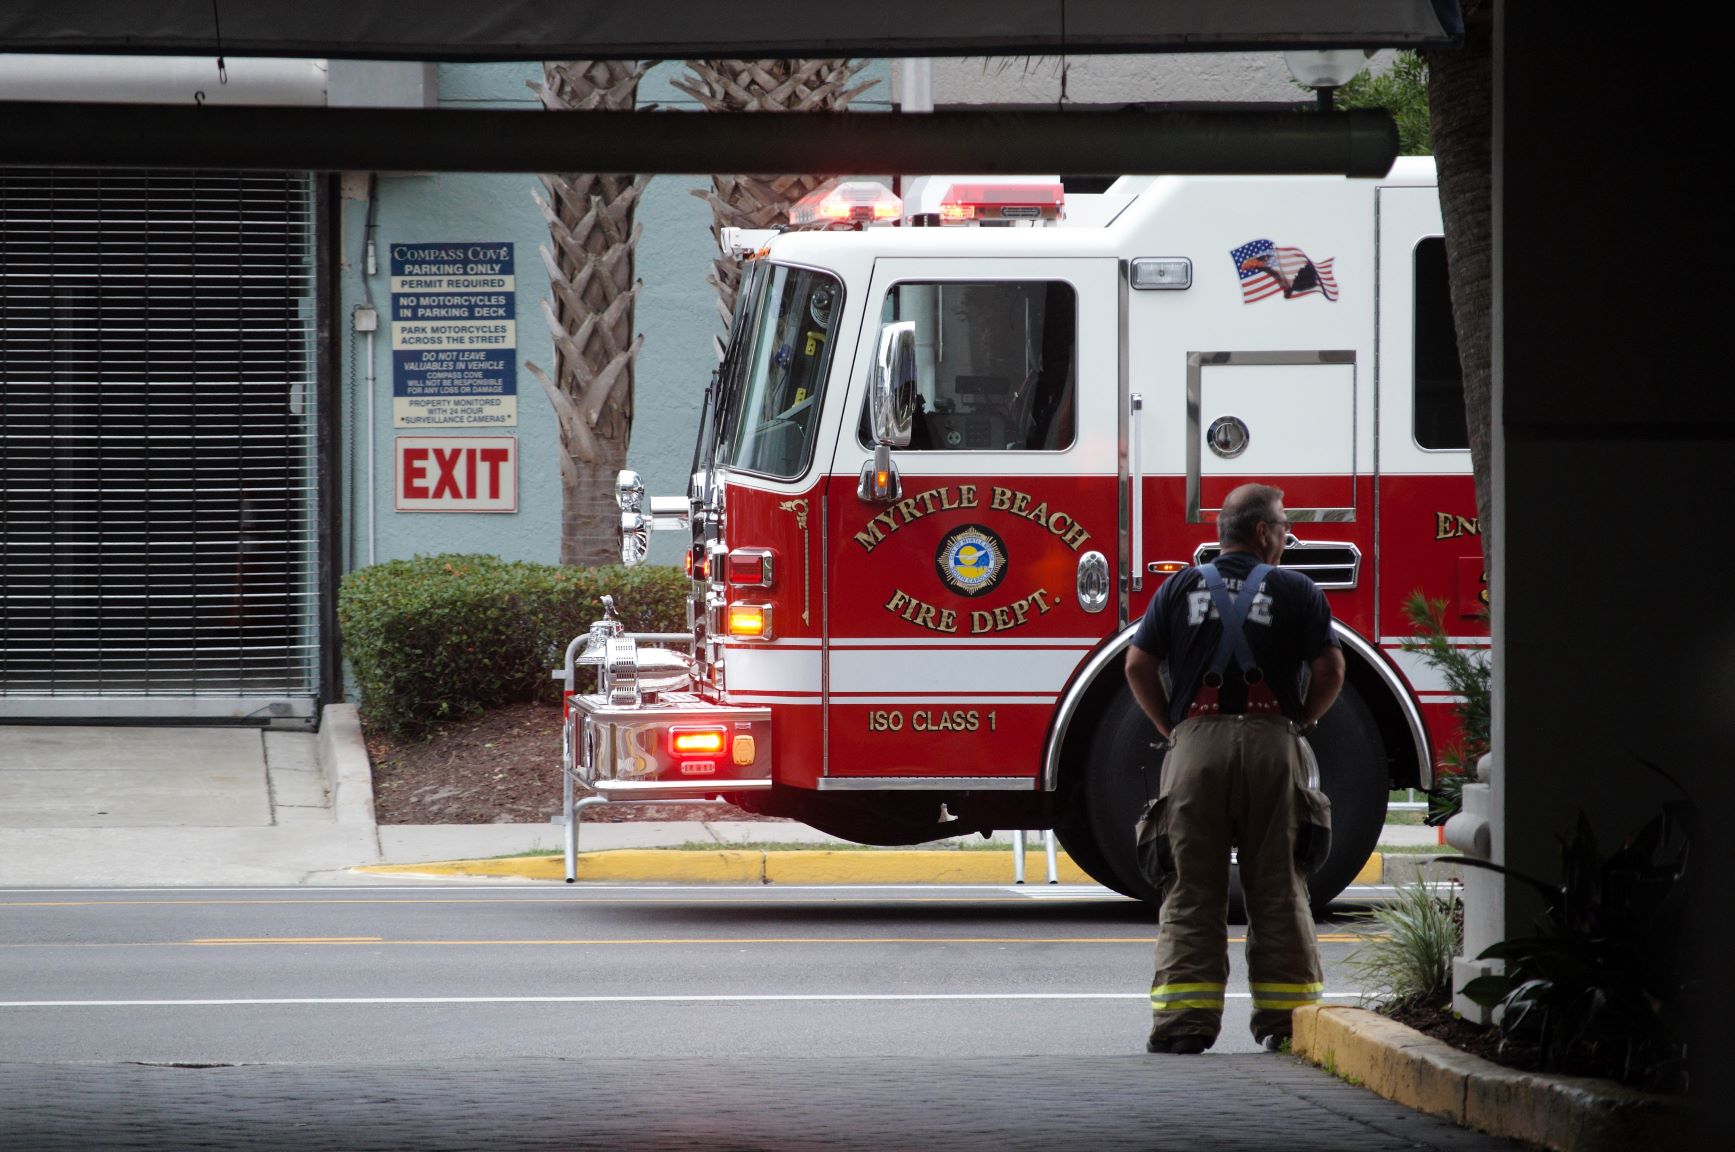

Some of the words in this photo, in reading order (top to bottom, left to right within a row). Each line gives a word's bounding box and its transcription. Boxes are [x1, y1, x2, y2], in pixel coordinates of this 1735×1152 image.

[404, 264, 463, 275] PARKING
[467, 264, 501, 274] ONLY
[401, 280, 443, 288] PERMIT
[447, 279, 505, 288] REQUIRED
[399, 297, 416, 306] NO
[419, 296, 506, 305] MOTORCYCLES
[399, 309, 412, 317] IN
[418, 308, 468, 317] PARKING
[474, 307, 506, 316] DECK
[431, 326, 507, 334] MOTORCYCLES
[446, 336, 465, 344] THE
[422, 352, 436, 361] DO
[438, 352, 458, 361] NOT
[459, 352, 486, 360] LEAVE
[404, 362, 454, 370] VALUABLES
[456, 361, 465, 369] IN
[468, 361, 504, 369] VEHICLE
[409, 399, 451, 407] PROPERTY
[405, 416, 464, 424] SURVEILLANCE
[466, 415, 506, 423] CAMERAS
[403, 448, 509, 499] EXIT
[853, 485, 979, 552] MYRTLE
[990, 486, 1092, 551] BEACH
[885, 589, 958, 633] FIRE
[970, 588, 1061, 634] DEPT.
[869, 711, 903, 731] ISO
[912, 711, 980, 731] CLASS
[987, 711, 997, 731] 1
